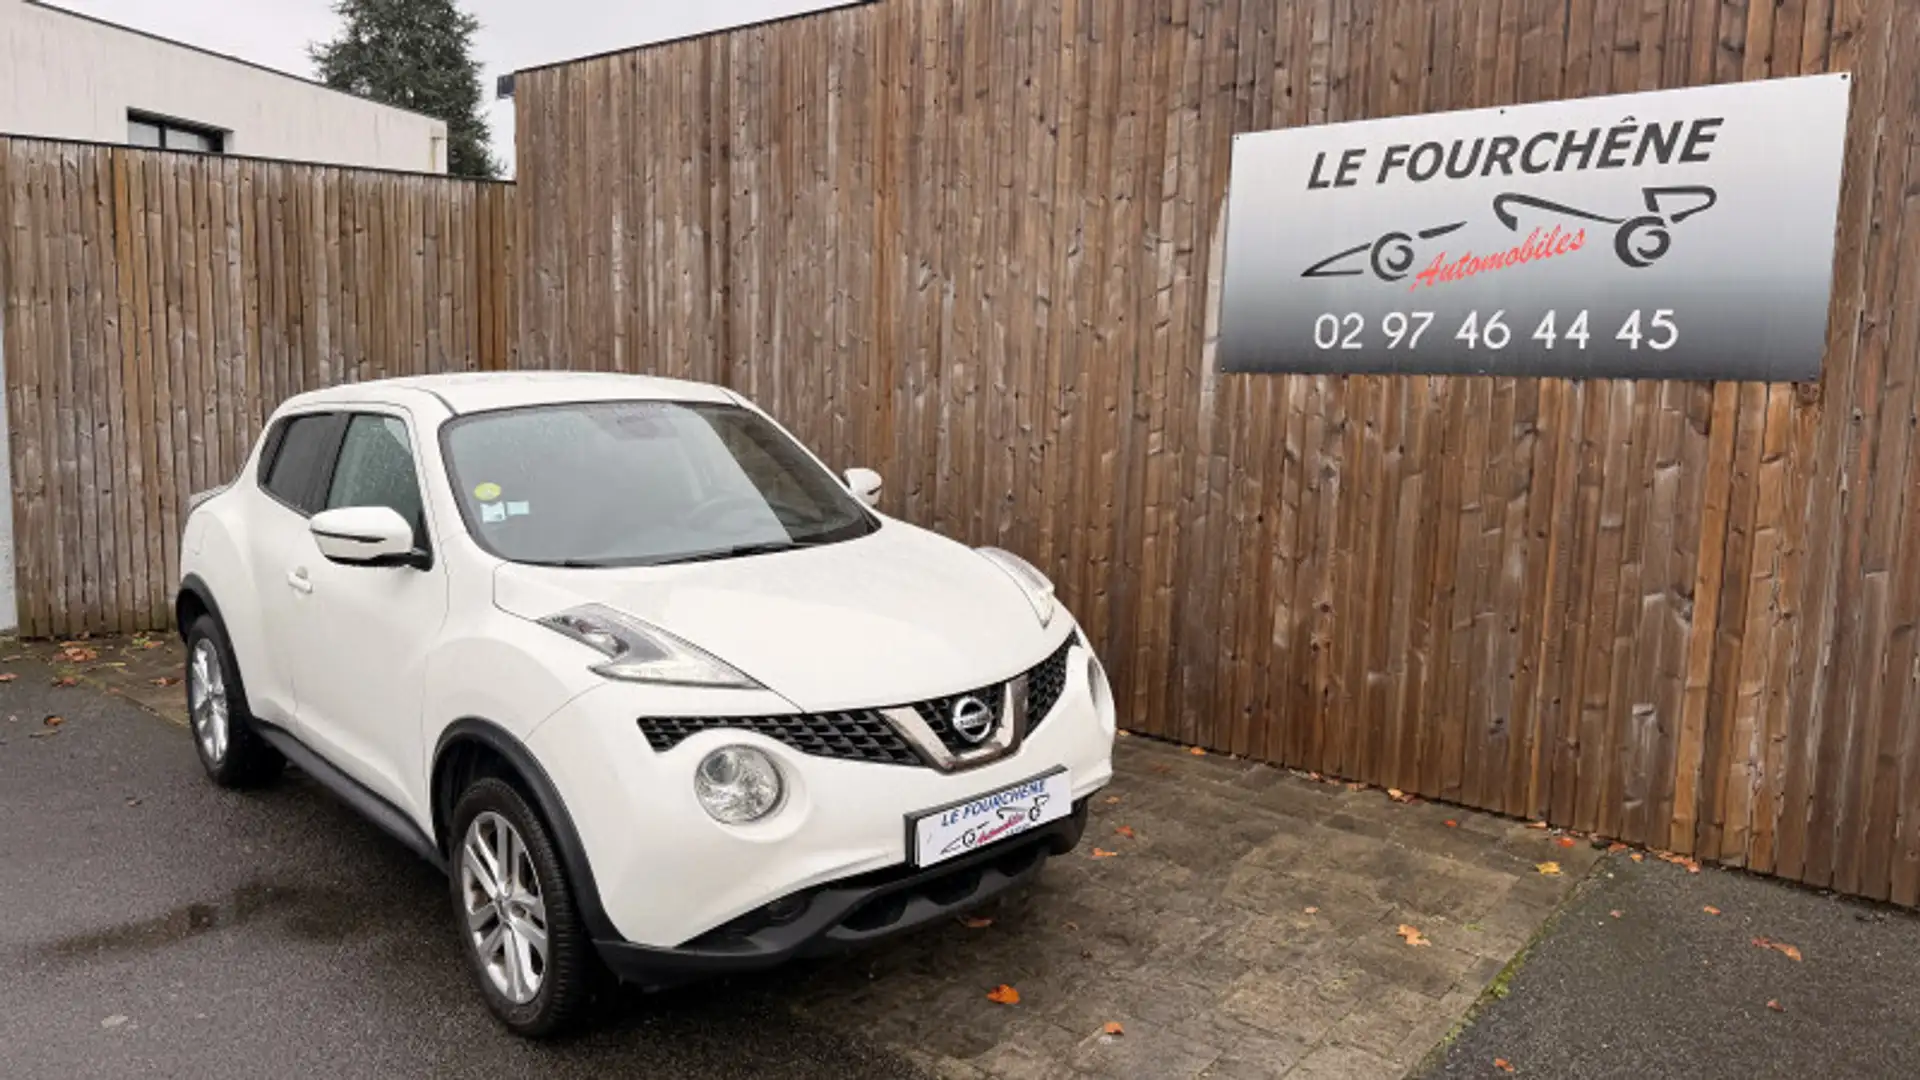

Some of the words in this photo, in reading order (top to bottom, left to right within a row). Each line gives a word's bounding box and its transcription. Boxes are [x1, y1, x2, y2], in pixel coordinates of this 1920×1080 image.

[1307, 148, 1367, 190] LE
[1376, 116, 1724, 184] FOURCHÊNE
[1409, 225, 1586, 292] Automobiles
[1313, 313, 1364, 351] 02
[1381, 311, 1434, 350] 97
[1455, 309, 1512, 350] 46
[1531, 309, 1591, 350] 44
[1615, 308, 1680, 350] 45
[940, 813, 959, 827] LE
